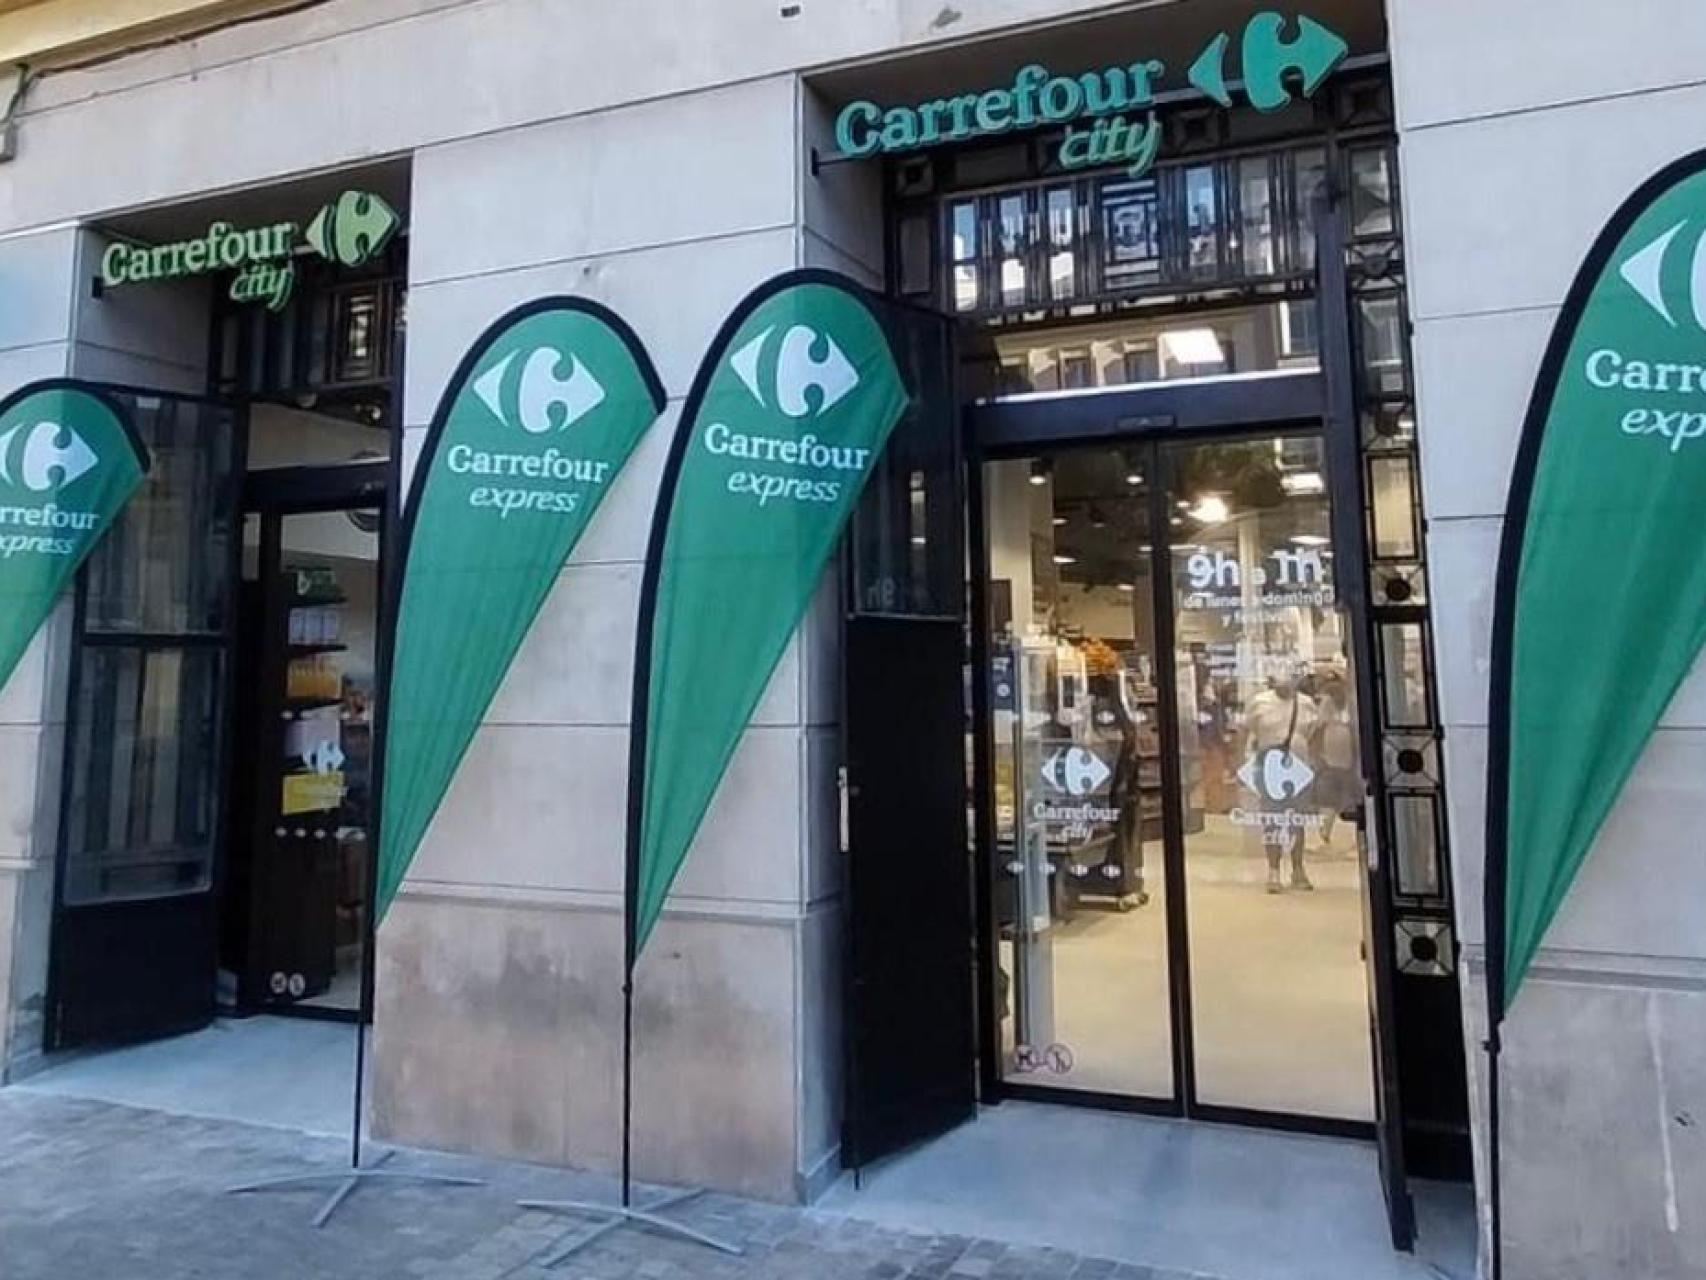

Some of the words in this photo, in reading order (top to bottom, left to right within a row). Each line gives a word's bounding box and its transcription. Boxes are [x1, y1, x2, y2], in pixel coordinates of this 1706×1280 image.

[834, 58, 1165, 158] Carrefour
[1057, 112, 1163, 178] city
[100, 221, 299, 287] Carrefour
[229, 260, 295, 312] city
[447, 443, 609, 484] Carrefour
[704, 422, 870, 471] Carrefour
[468, 486, 580, 520] express
[727, 470, 842, 508] express
[1187, 550, 1241, 588] 9h
[1032, 801, 1121, 822] Carrefour
